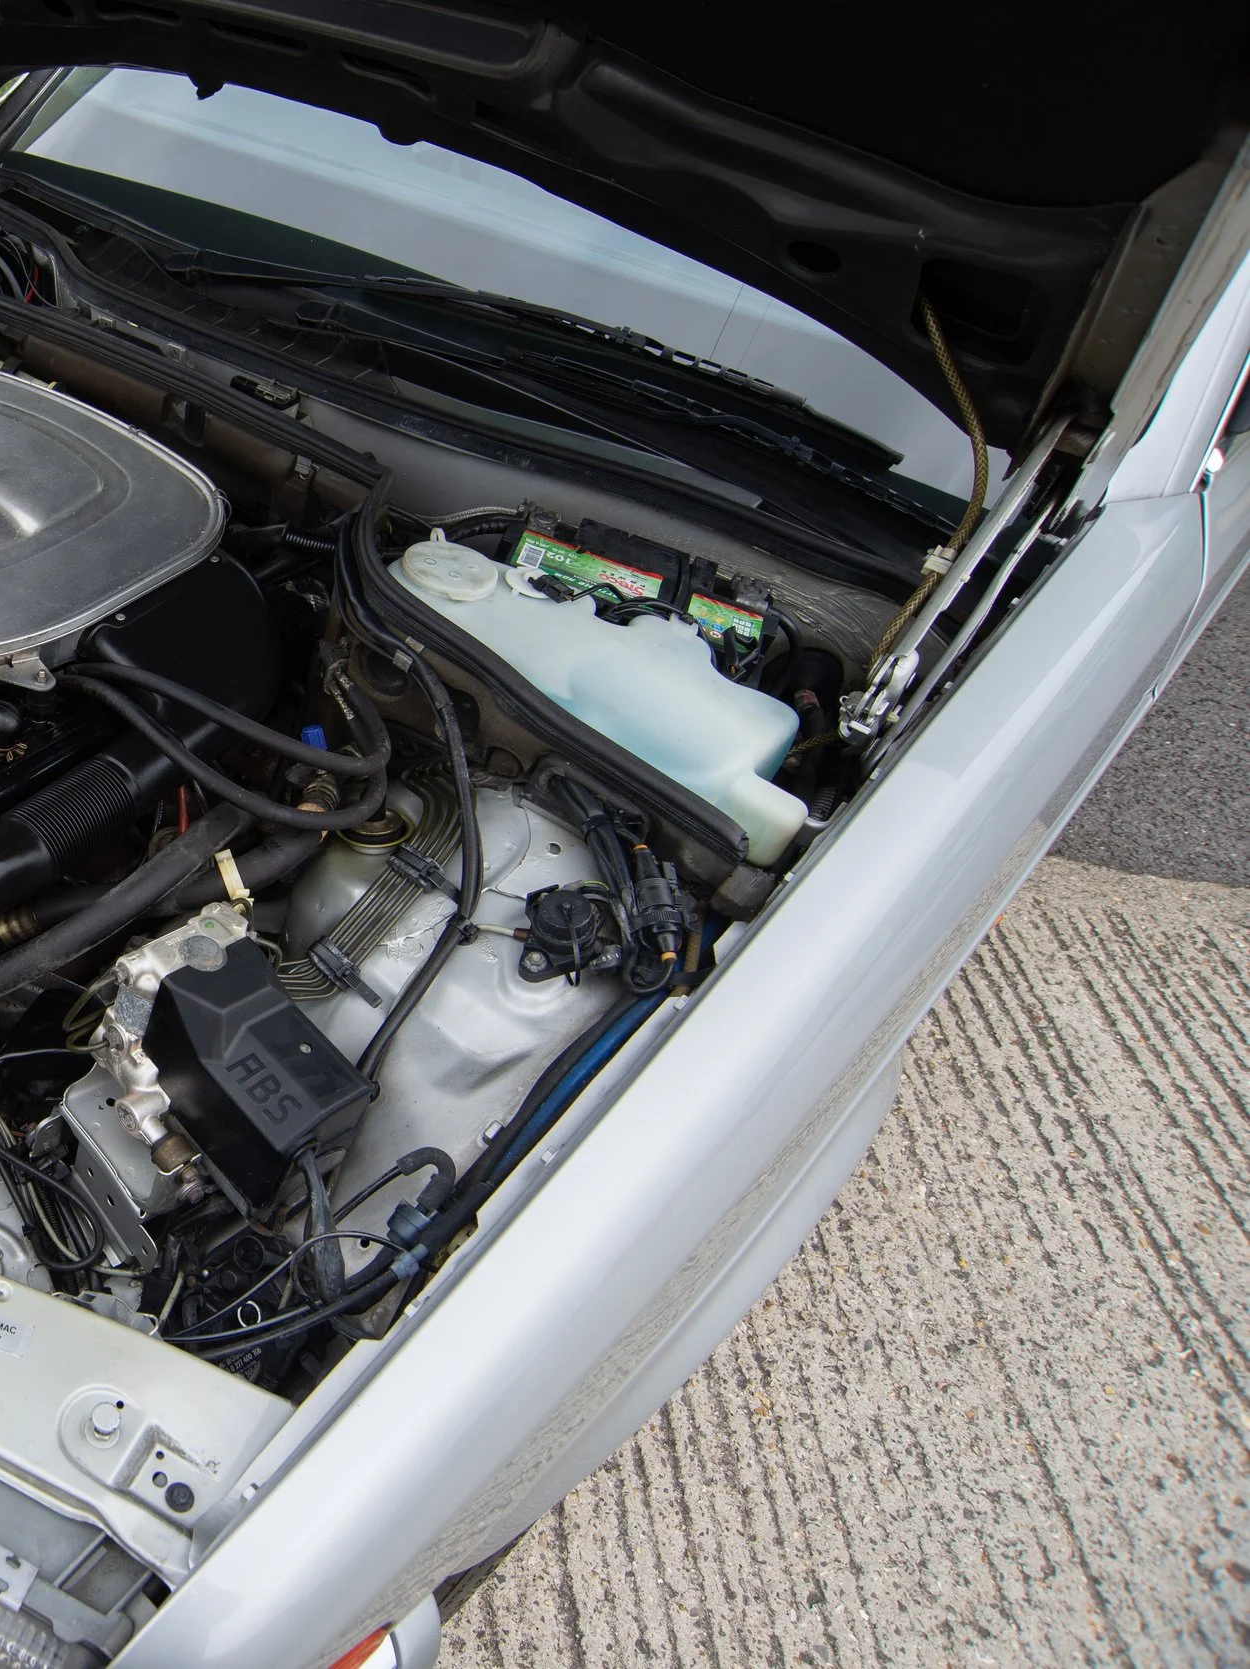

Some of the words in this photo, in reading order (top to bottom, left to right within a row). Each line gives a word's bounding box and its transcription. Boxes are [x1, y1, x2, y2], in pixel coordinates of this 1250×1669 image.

[547, 551, 571, 564] 102
[601, 570, 645, 587] POWER
[226, 1053, 304, 1125] ABS
